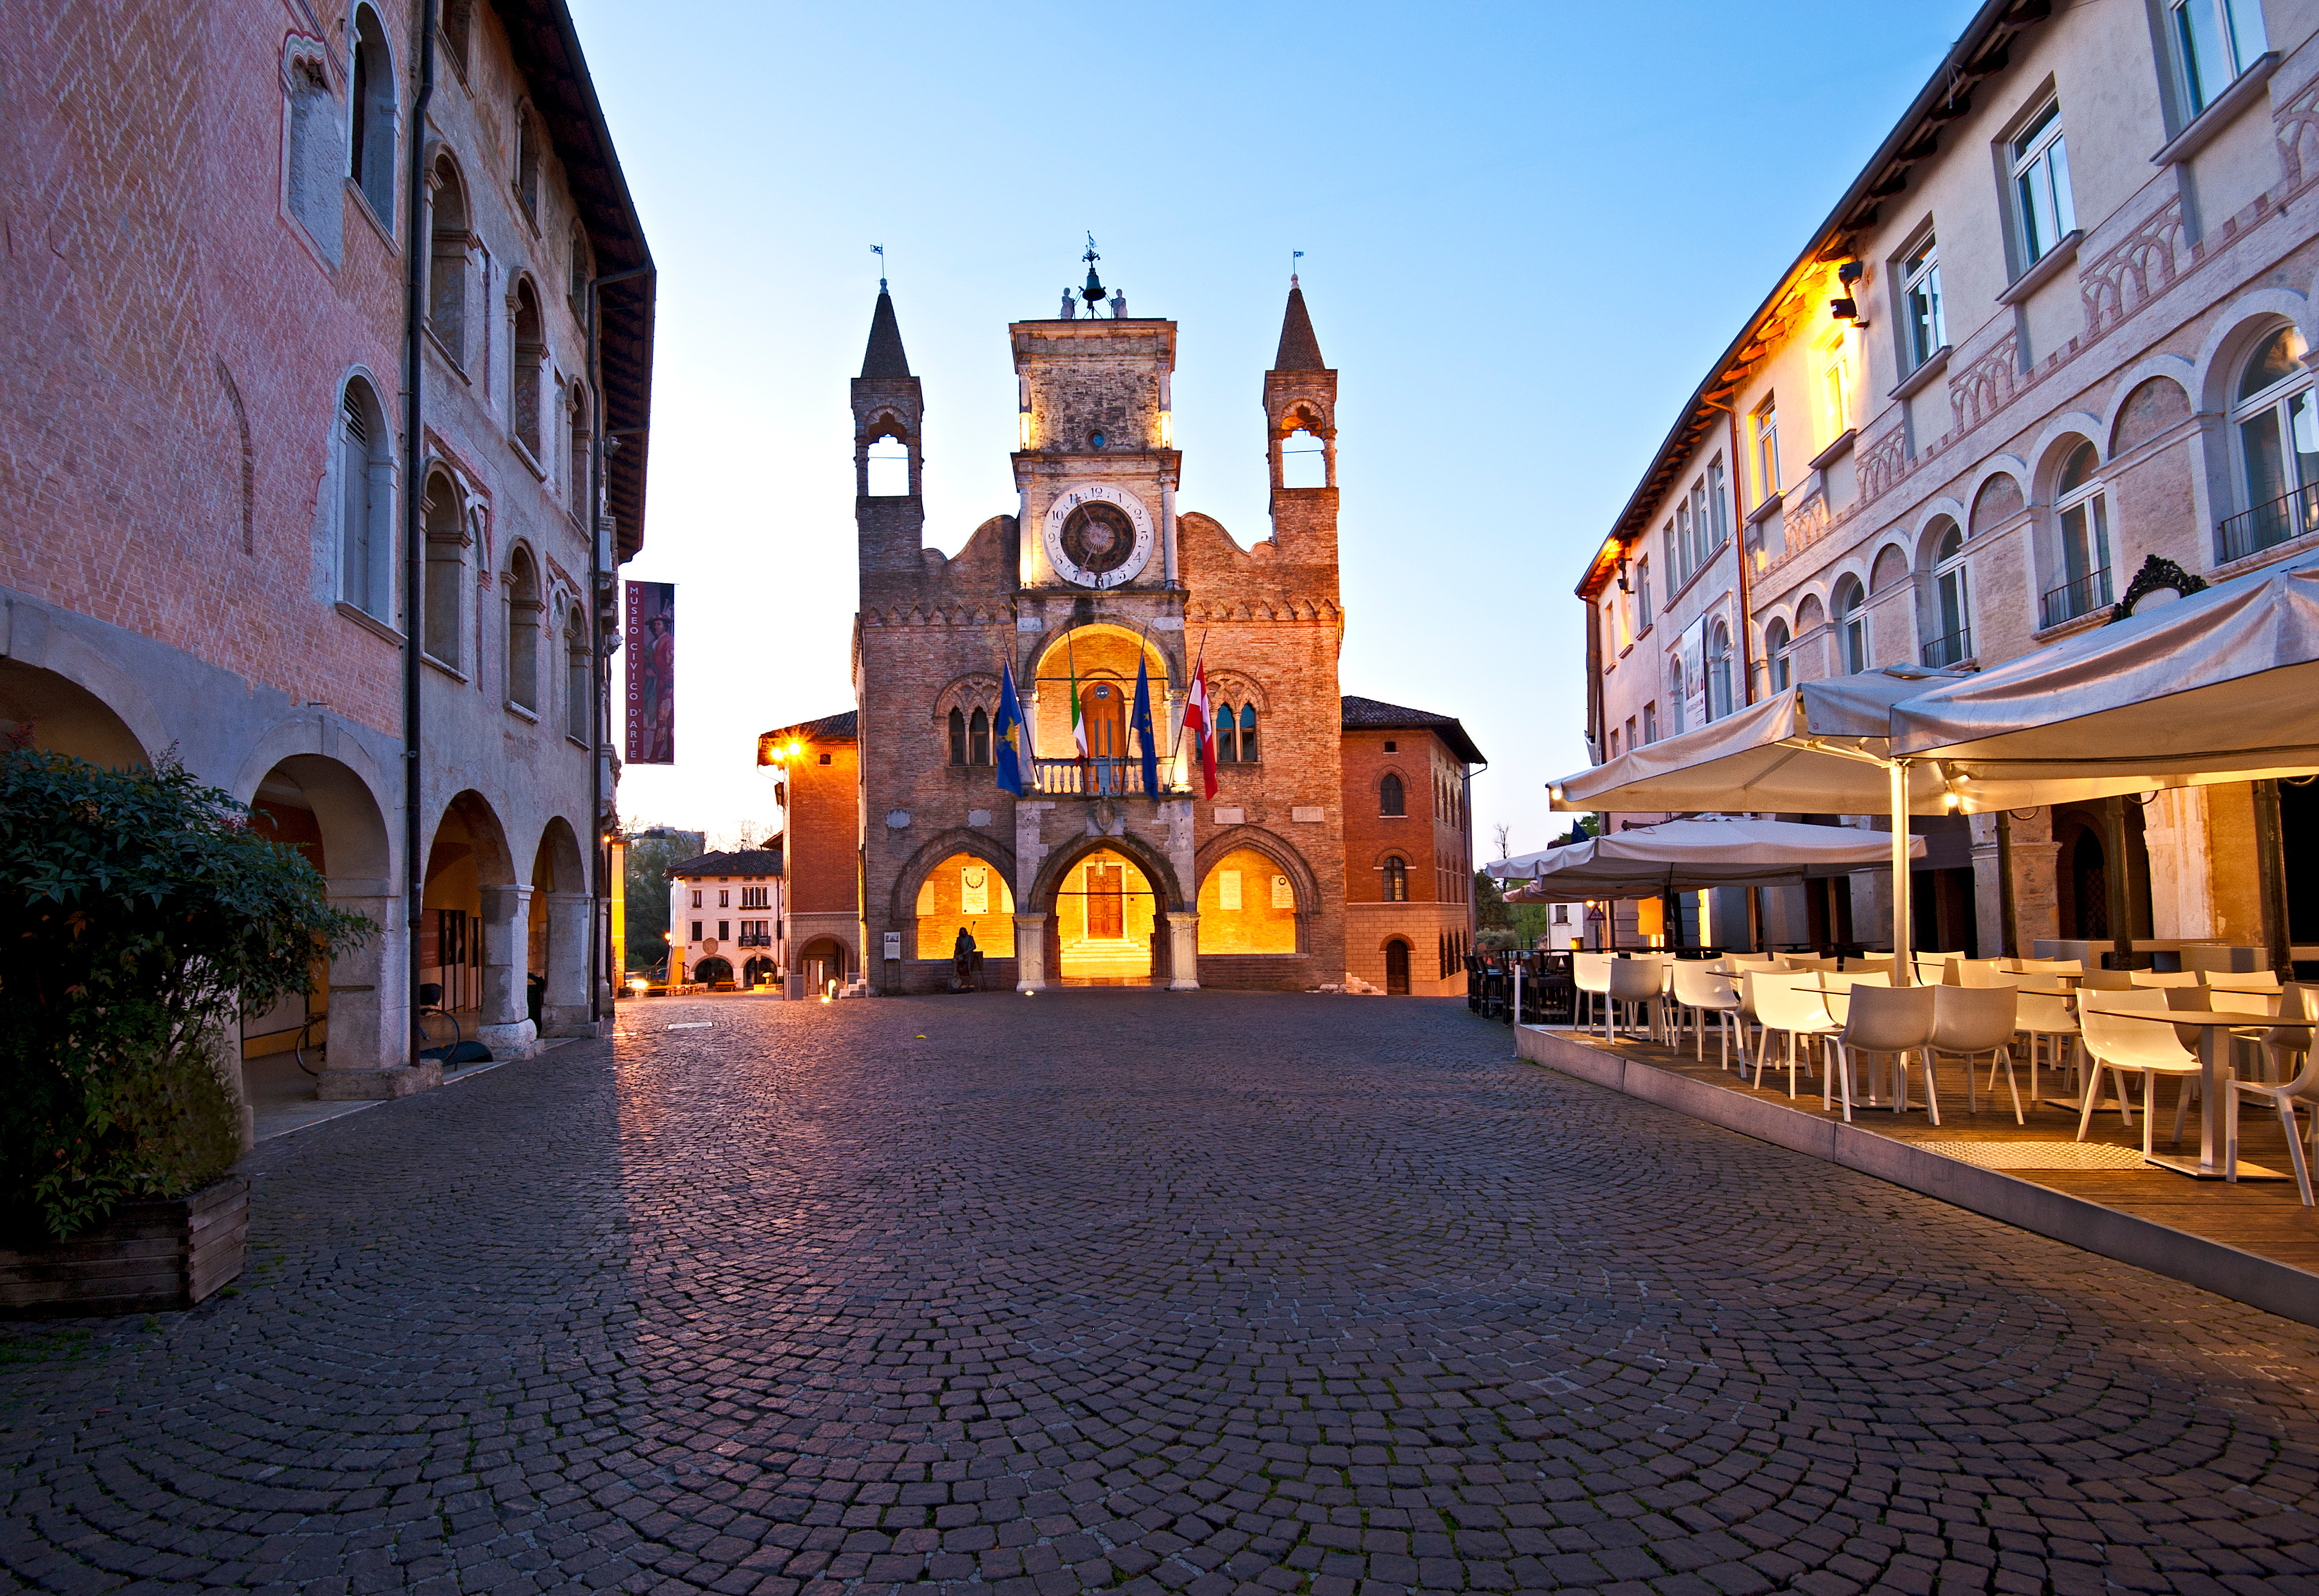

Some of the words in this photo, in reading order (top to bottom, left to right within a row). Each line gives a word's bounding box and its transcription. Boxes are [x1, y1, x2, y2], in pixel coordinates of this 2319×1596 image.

[1090, 487, 1103, 497] 12
[1118, 493, 1122, 503] 1
[1052, 510, 1063, 520] 10
[1134, 509, 1142, 519] 2
[1048, 533, 1056, 543] 9
[1055, 554, 1063, 565] 8
[1133, 552, 1142, 563] 4
[1073, 570, 1079, 581] 7
[1119, 569, 1126, 580] 5
[629, 587, 638, 634] MUSEO
[629, 643, 638, 700] CIVICO
[629, 709, 641, 758] D'ARTE
